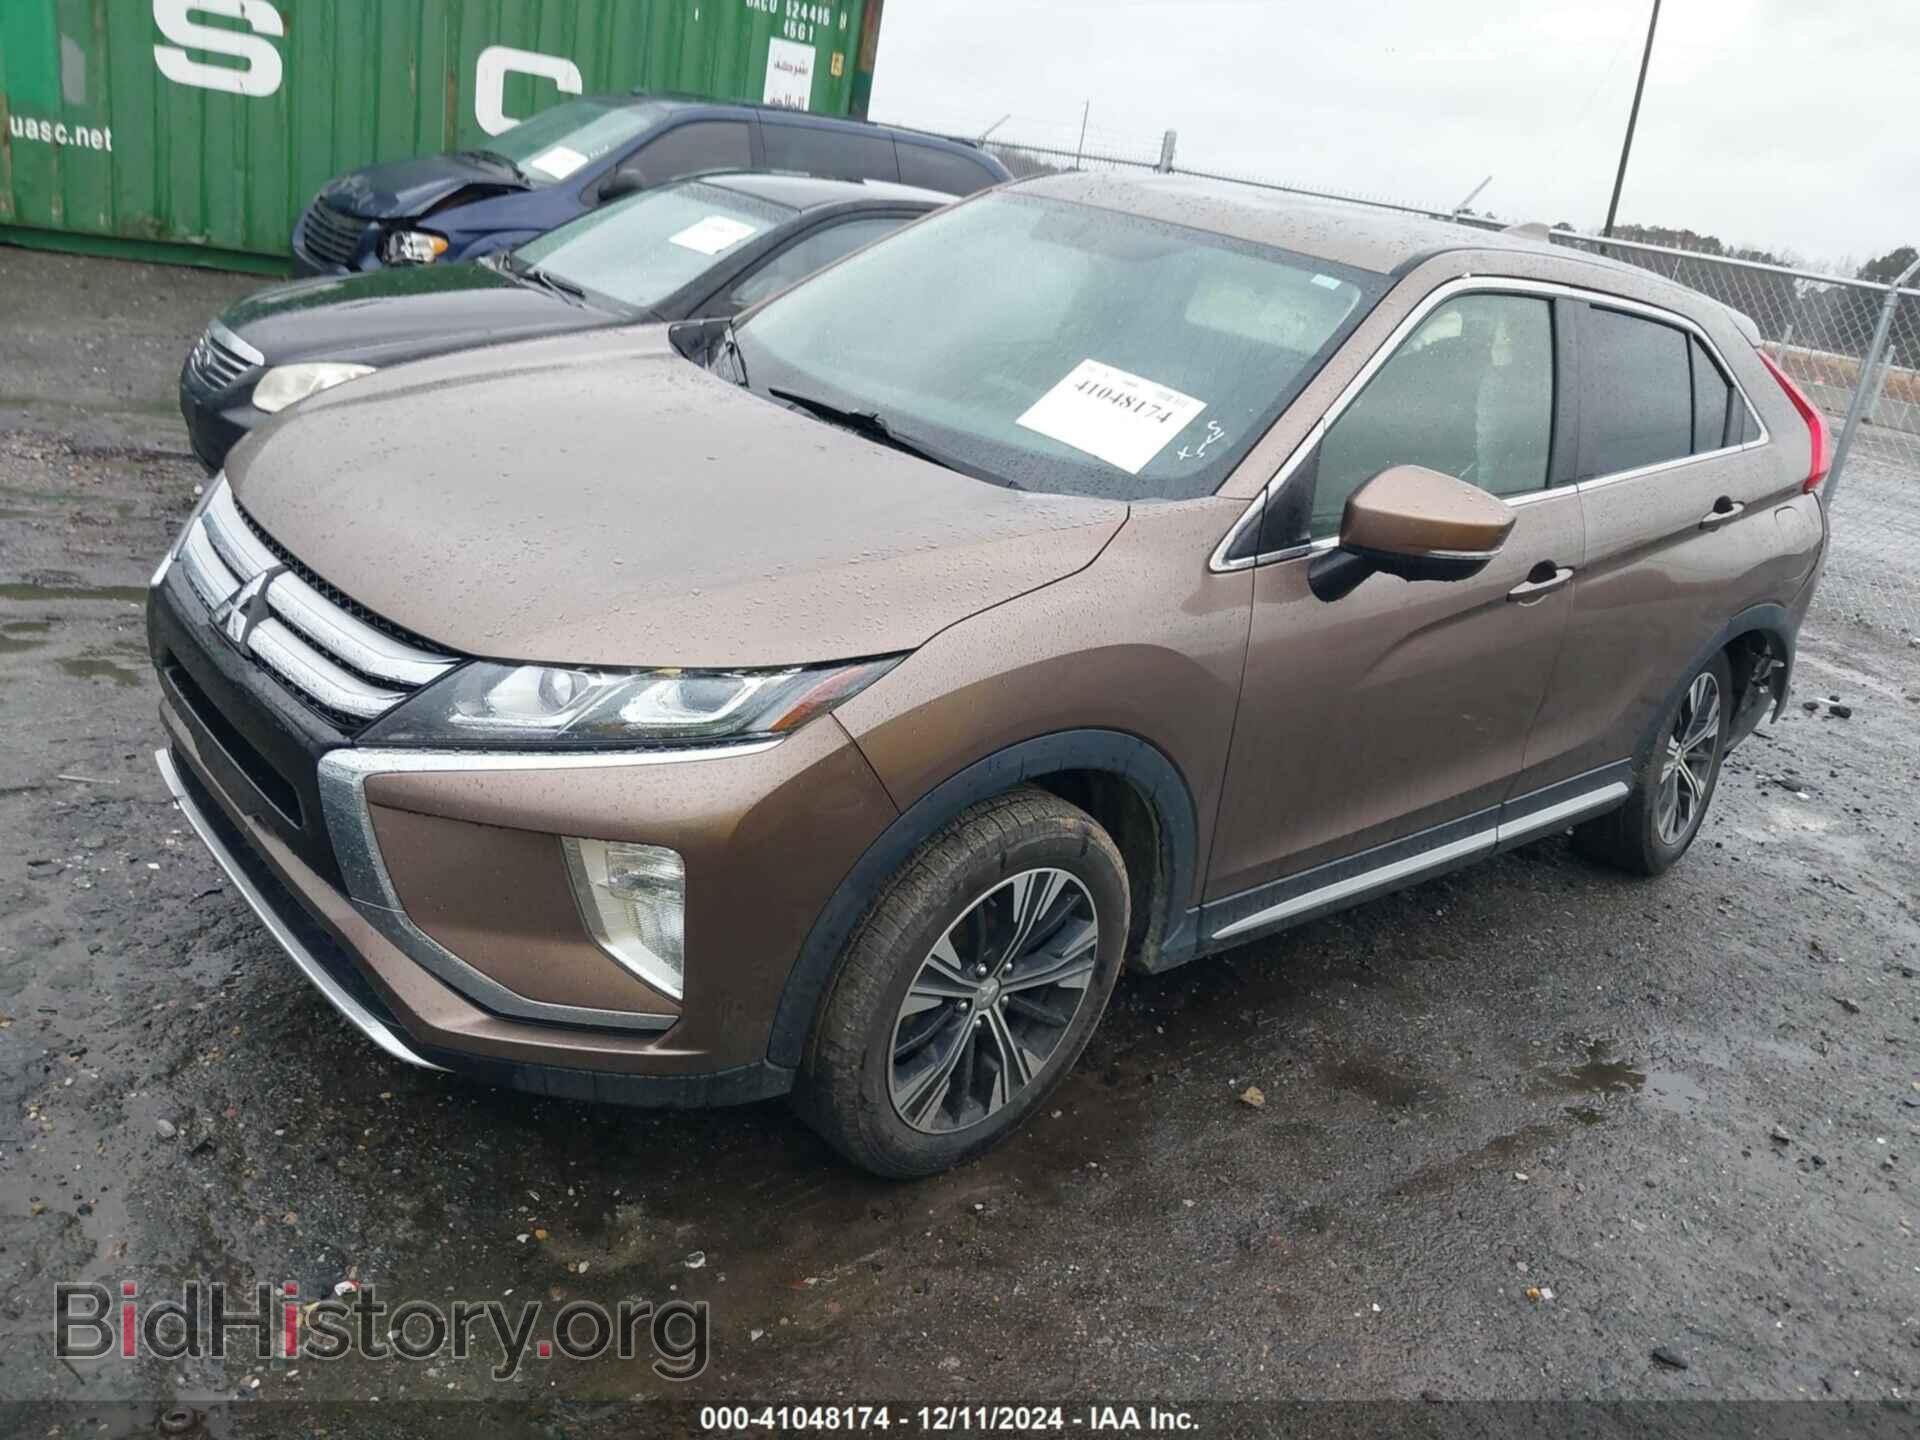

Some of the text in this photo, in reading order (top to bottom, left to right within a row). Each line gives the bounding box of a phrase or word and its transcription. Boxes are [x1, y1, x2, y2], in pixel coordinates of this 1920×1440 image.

[154, 0, 583, 137] S C
[9, 115, 113, 153] uasc.net
[1076, 380, 1174, 423] 41048174
